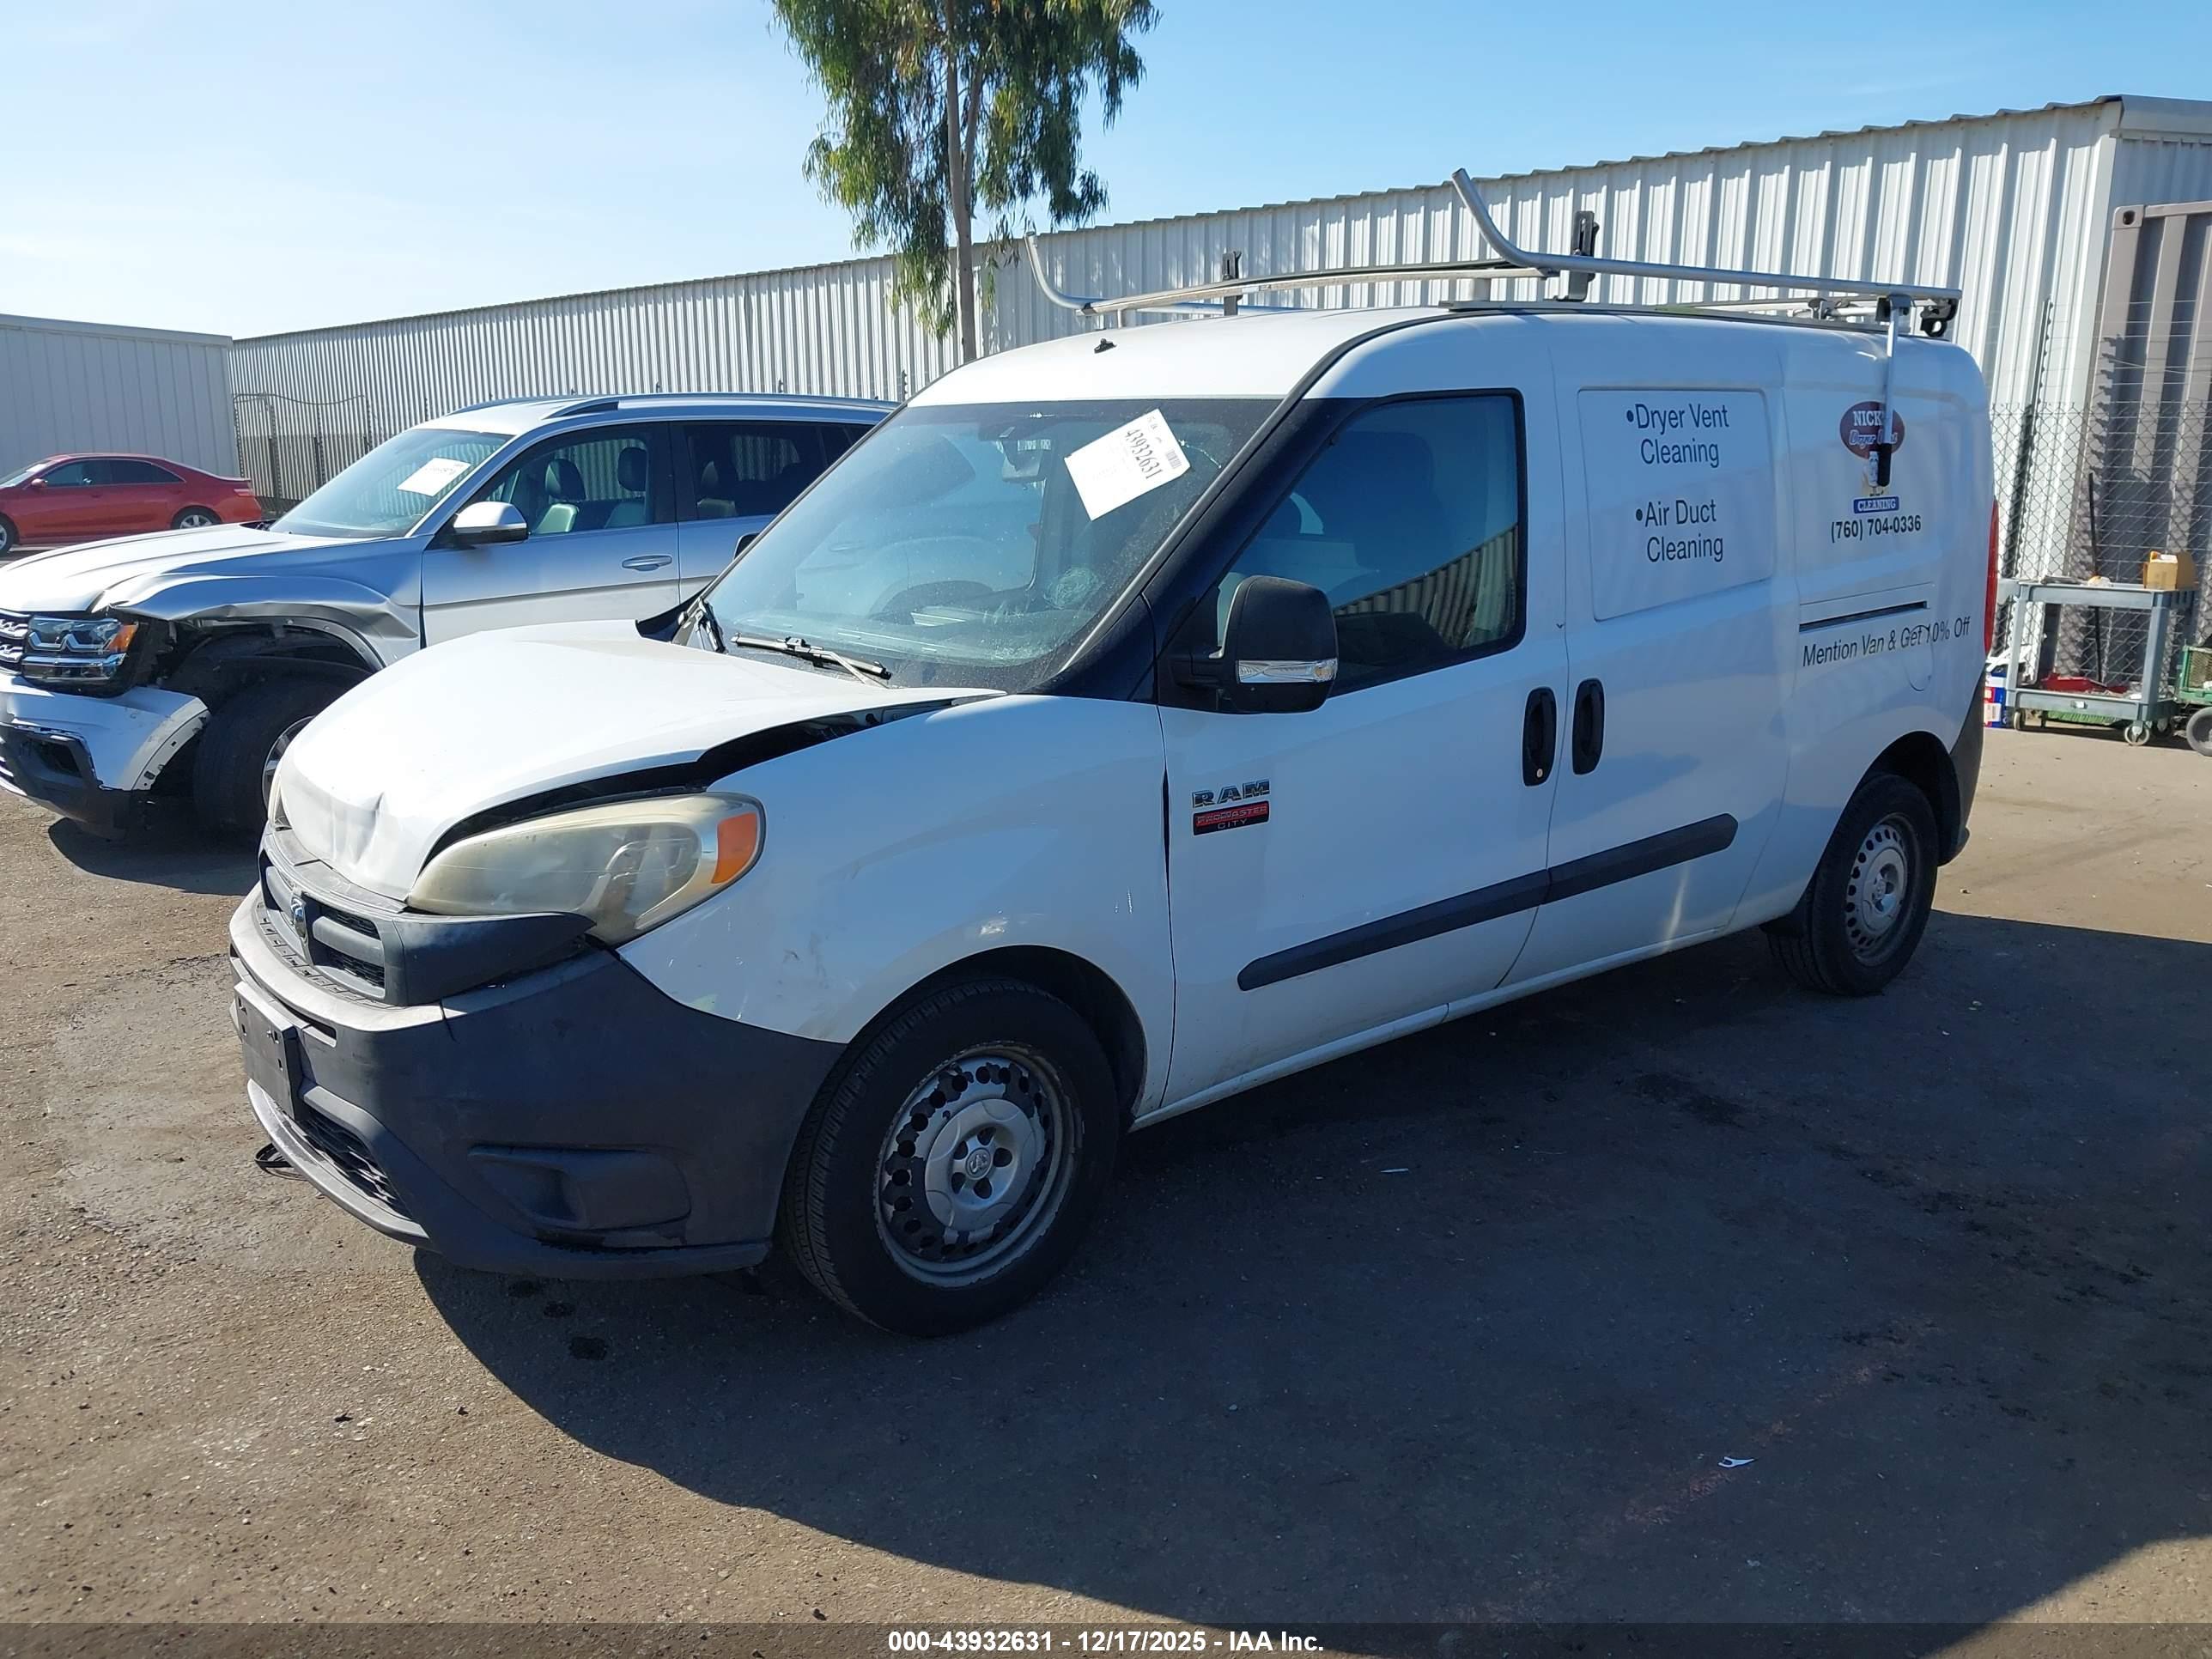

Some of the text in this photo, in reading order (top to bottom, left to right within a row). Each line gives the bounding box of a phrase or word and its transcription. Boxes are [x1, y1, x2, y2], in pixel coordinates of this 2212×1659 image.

[1635, 404, 1729, 435] Dryer Vent
[1125, 428, 1164, 479] 43932631
[1641, 438, 1719, 468] Cleaning
[1644, 499, 1717, 527] Air Duct
[1857, 498, 1897, 512] CLEANING
[1831, 514, 1922, 543] (760) 704-0336
[1647, 532, 1723, 562] Cleaning
[1803, 616, 1971, 666] Mention Van & Get 10% Off
[1192, 778, 1270, 808] RAM
[1196, 805, 1267, 824] PROMASTER
[1217, 818, 1249, 830] CITY
